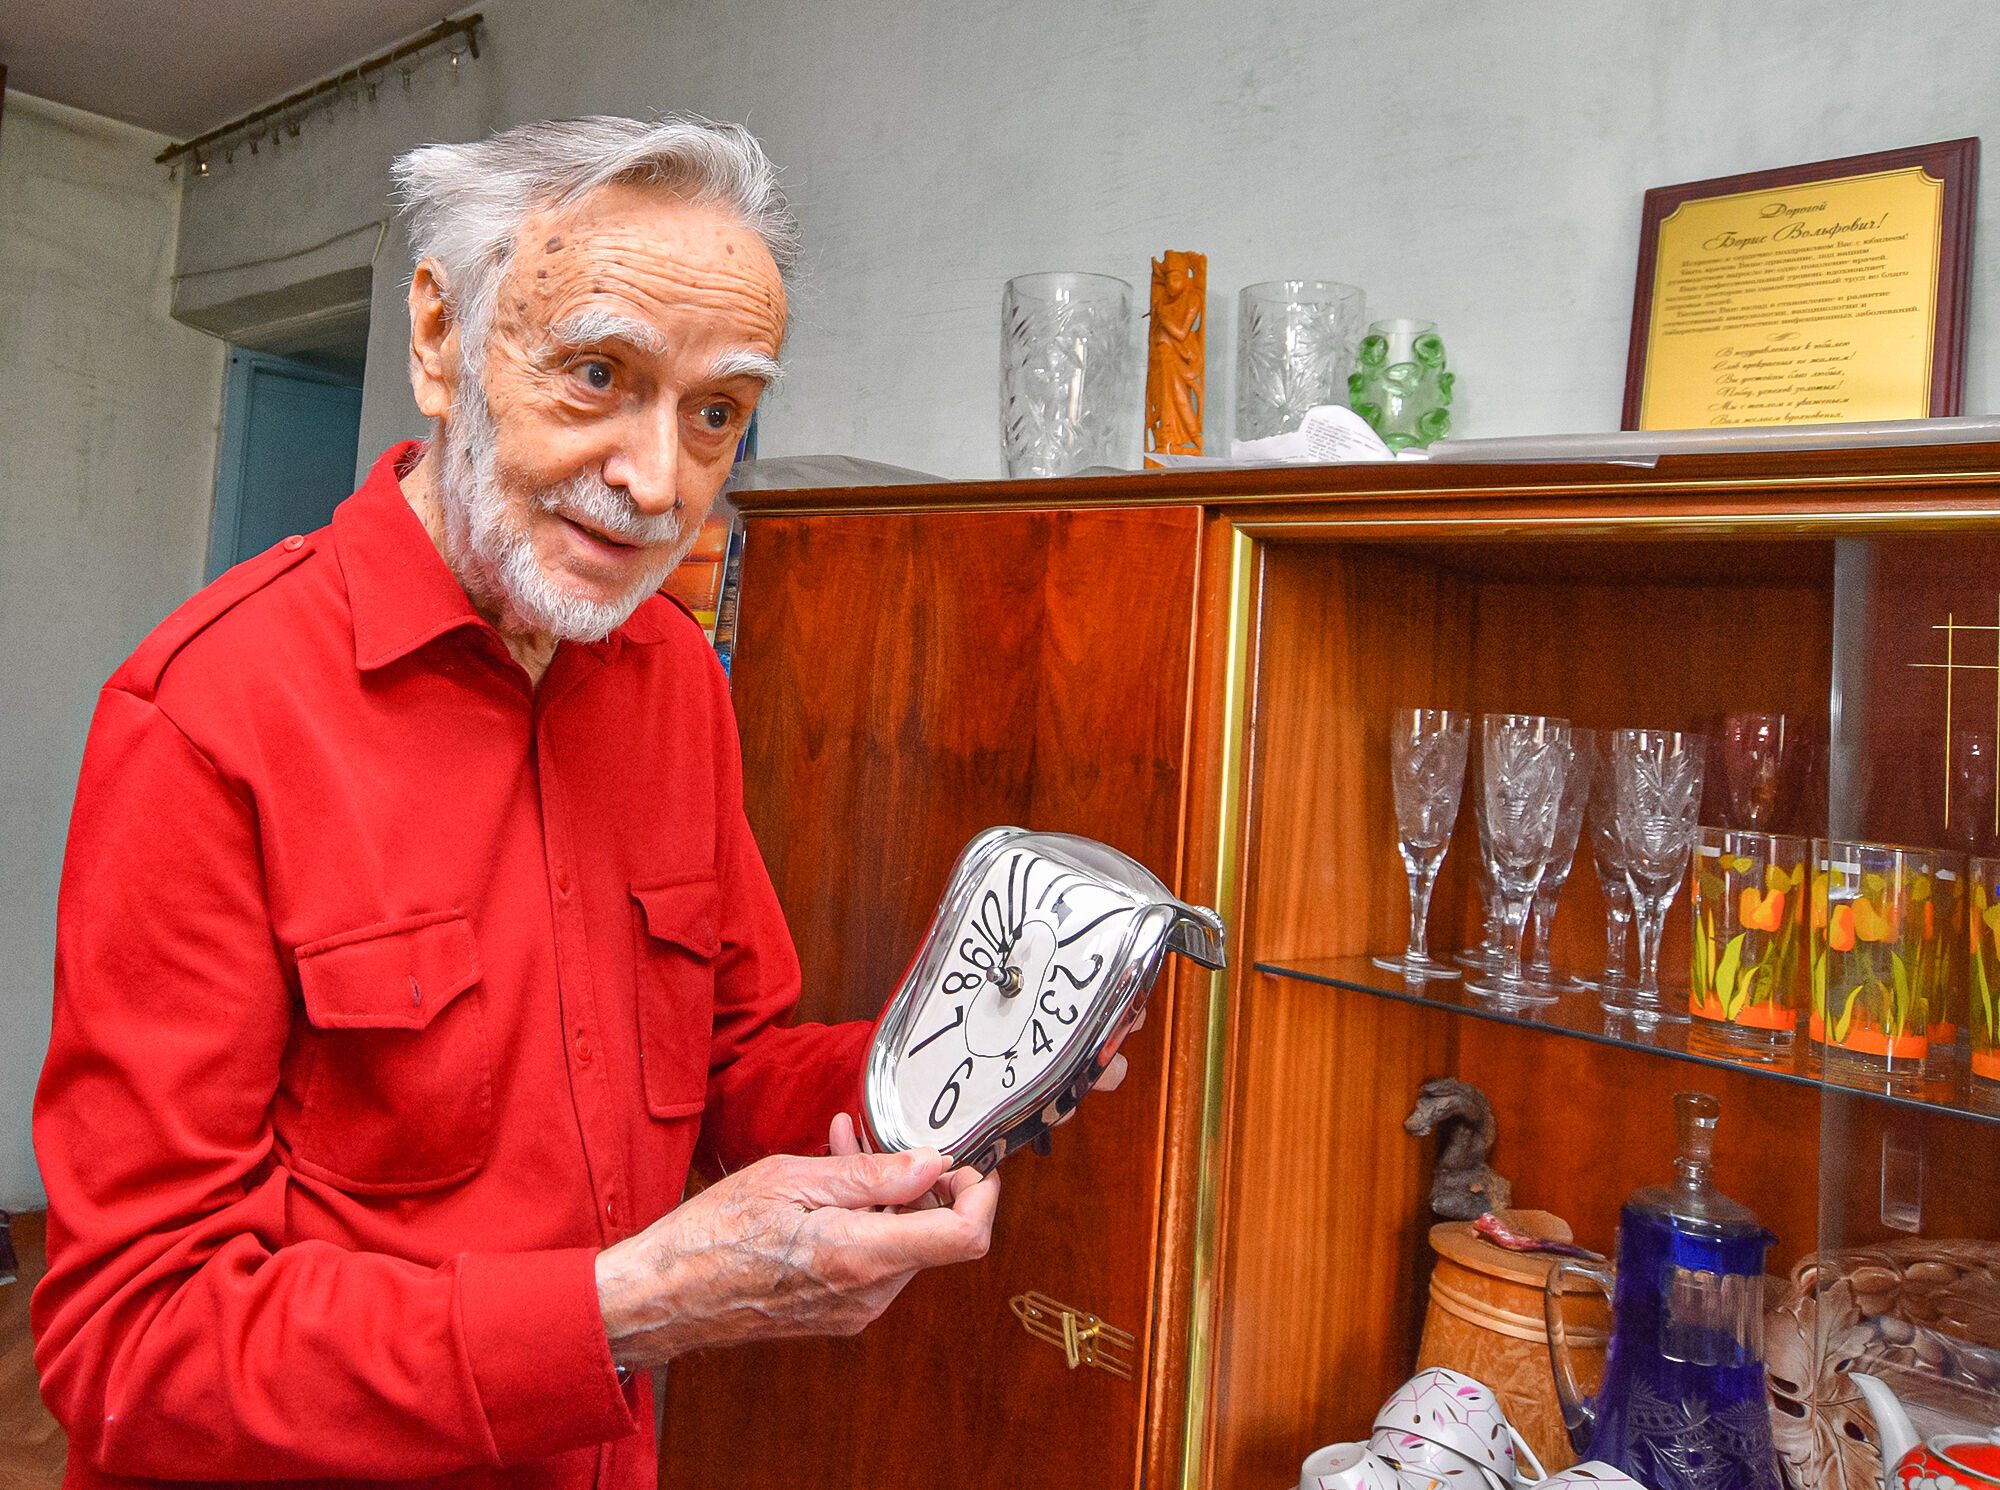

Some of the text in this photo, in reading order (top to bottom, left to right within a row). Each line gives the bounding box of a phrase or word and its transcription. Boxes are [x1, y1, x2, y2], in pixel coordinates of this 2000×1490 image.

[1758, 201, 1828, 220] Дорогой
[1702, 212, 1889, 251] Борис Вольфович!
[942, 970, 982, 996] 8
[1048, 953, 1105, 991] 2
[1040, 990, 1080, 1025] 3
[908, 1005, 964, 1058] 7
[1031, 1019, 1054, 1056] 4
[1001, 1052, 1018, 1090] 5
[928, 1056, 974, 1130] 6
